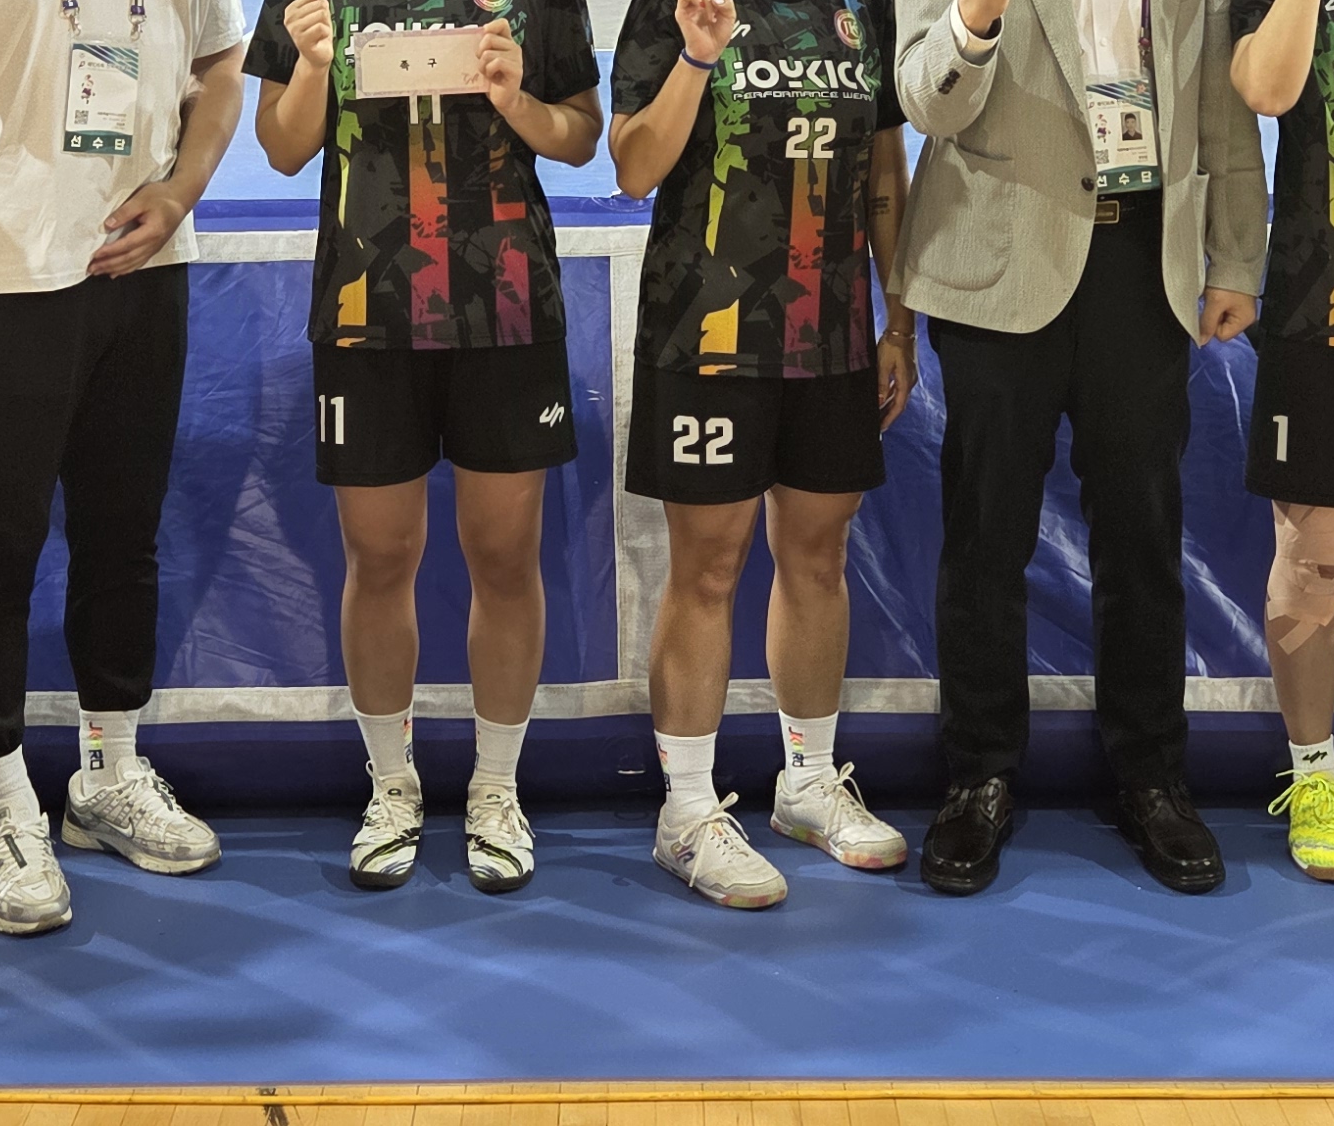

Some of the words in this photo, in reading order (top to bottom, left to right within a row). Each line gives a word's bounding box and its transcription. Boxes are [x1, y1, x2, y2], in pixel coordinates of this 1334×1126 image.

[733, 90, 840, 100] PERFORMANCE
[70, 135, 125, 151] 선수단
[785, 117, 837, 159] 22
[1097, 170, 1152, 188] 선수단
[318, 394, 344, 444] 11
[673, 415, 733, 464] 22
[1273, 415, 1288, 462] 1
